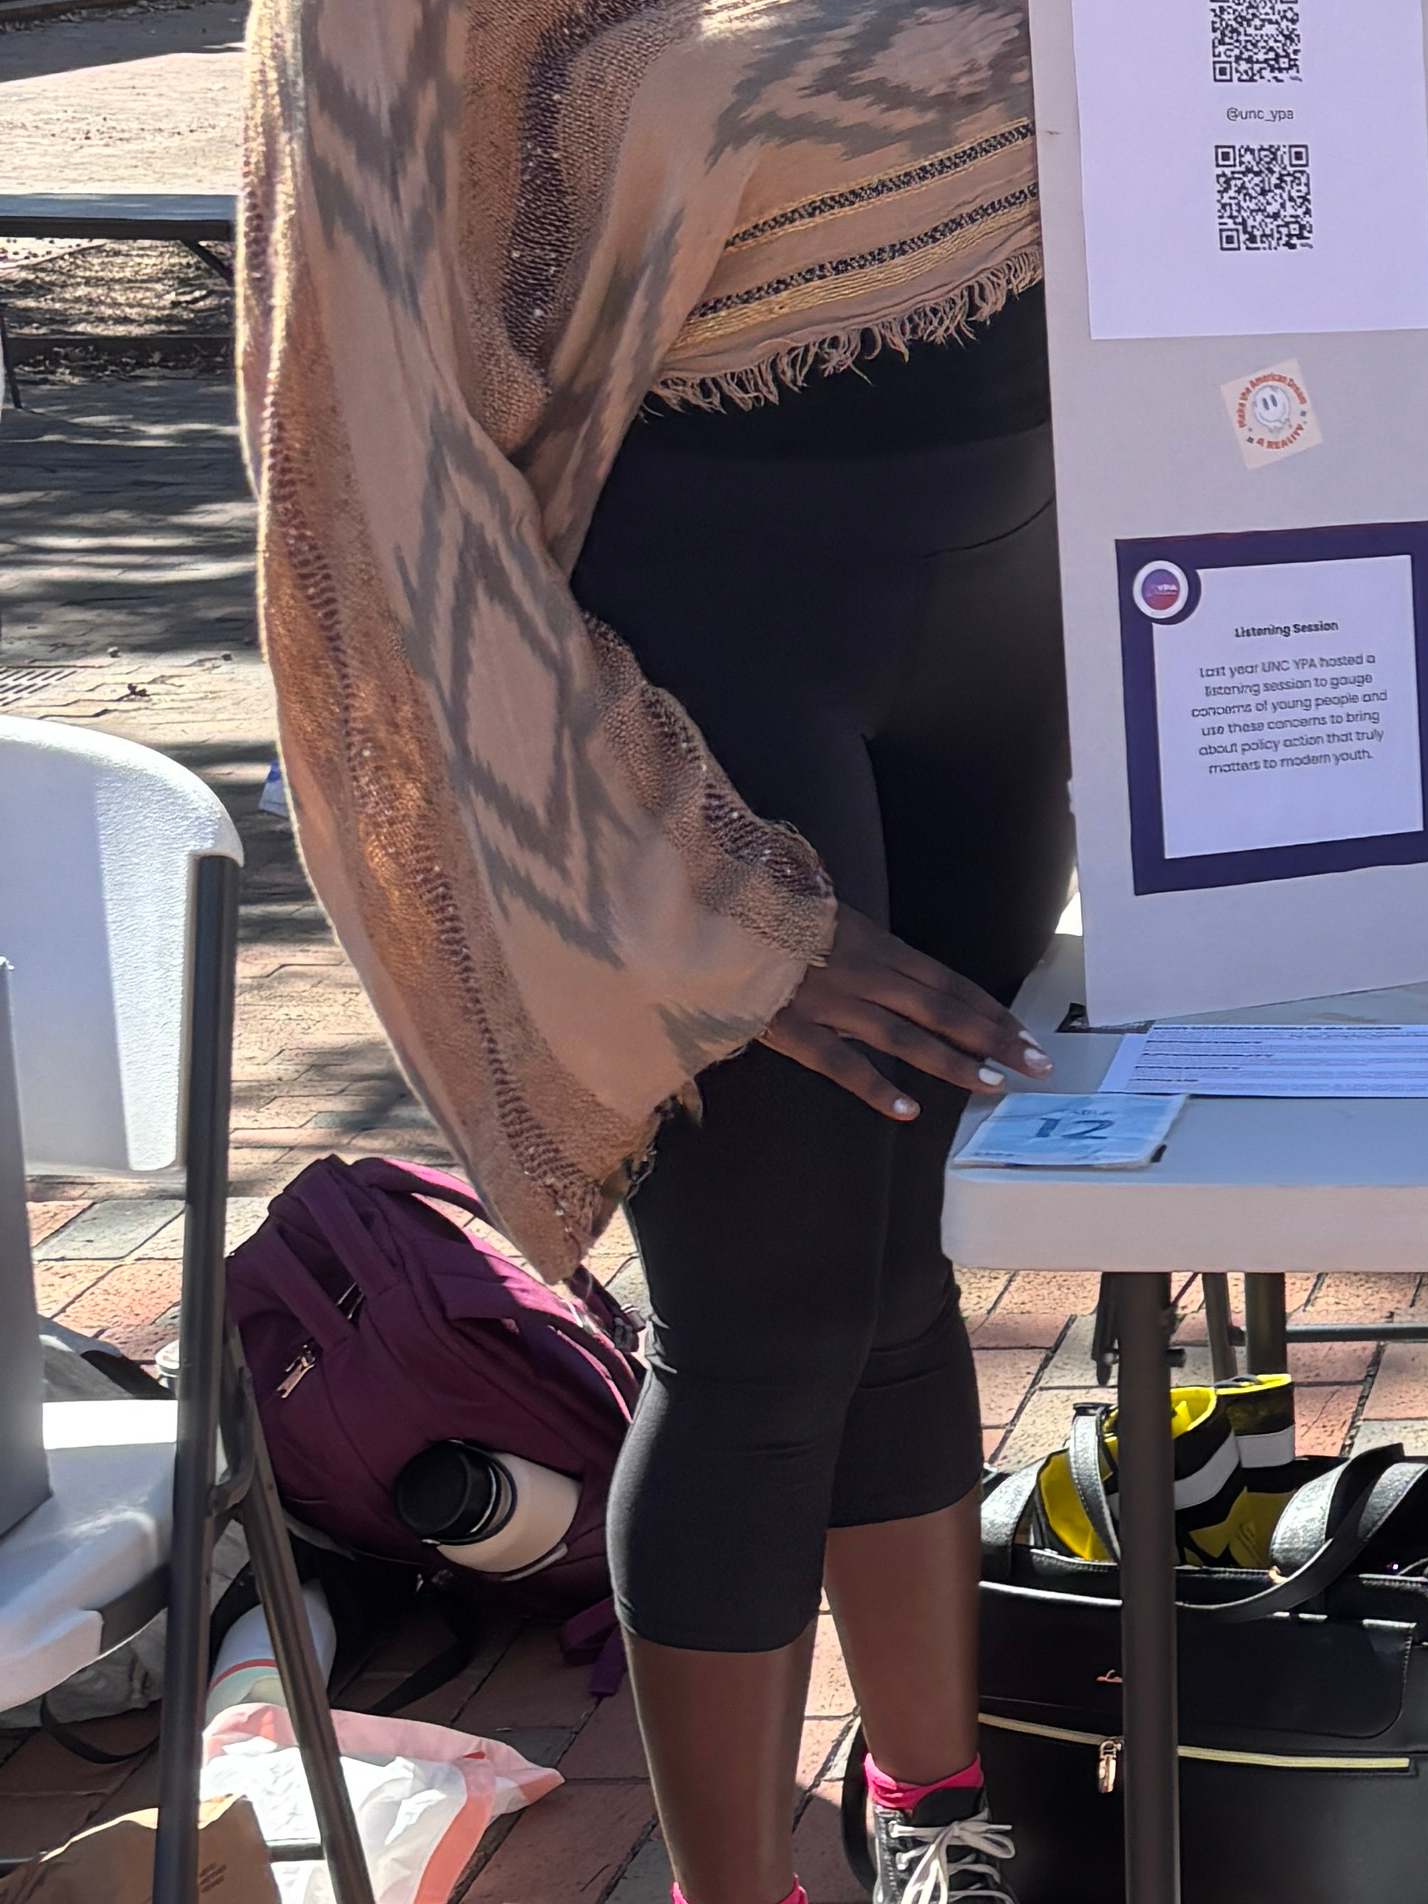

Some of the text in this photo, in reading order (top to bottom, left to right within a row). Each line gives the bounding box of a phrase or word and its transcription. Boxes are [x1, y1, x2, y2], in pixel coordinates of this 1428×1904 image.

[1227, 107, 1294, 122] @unc_ypa
[1234, 620, 1339, 638] Listening Session
[1035, 1117, 1115, 1139] 12
